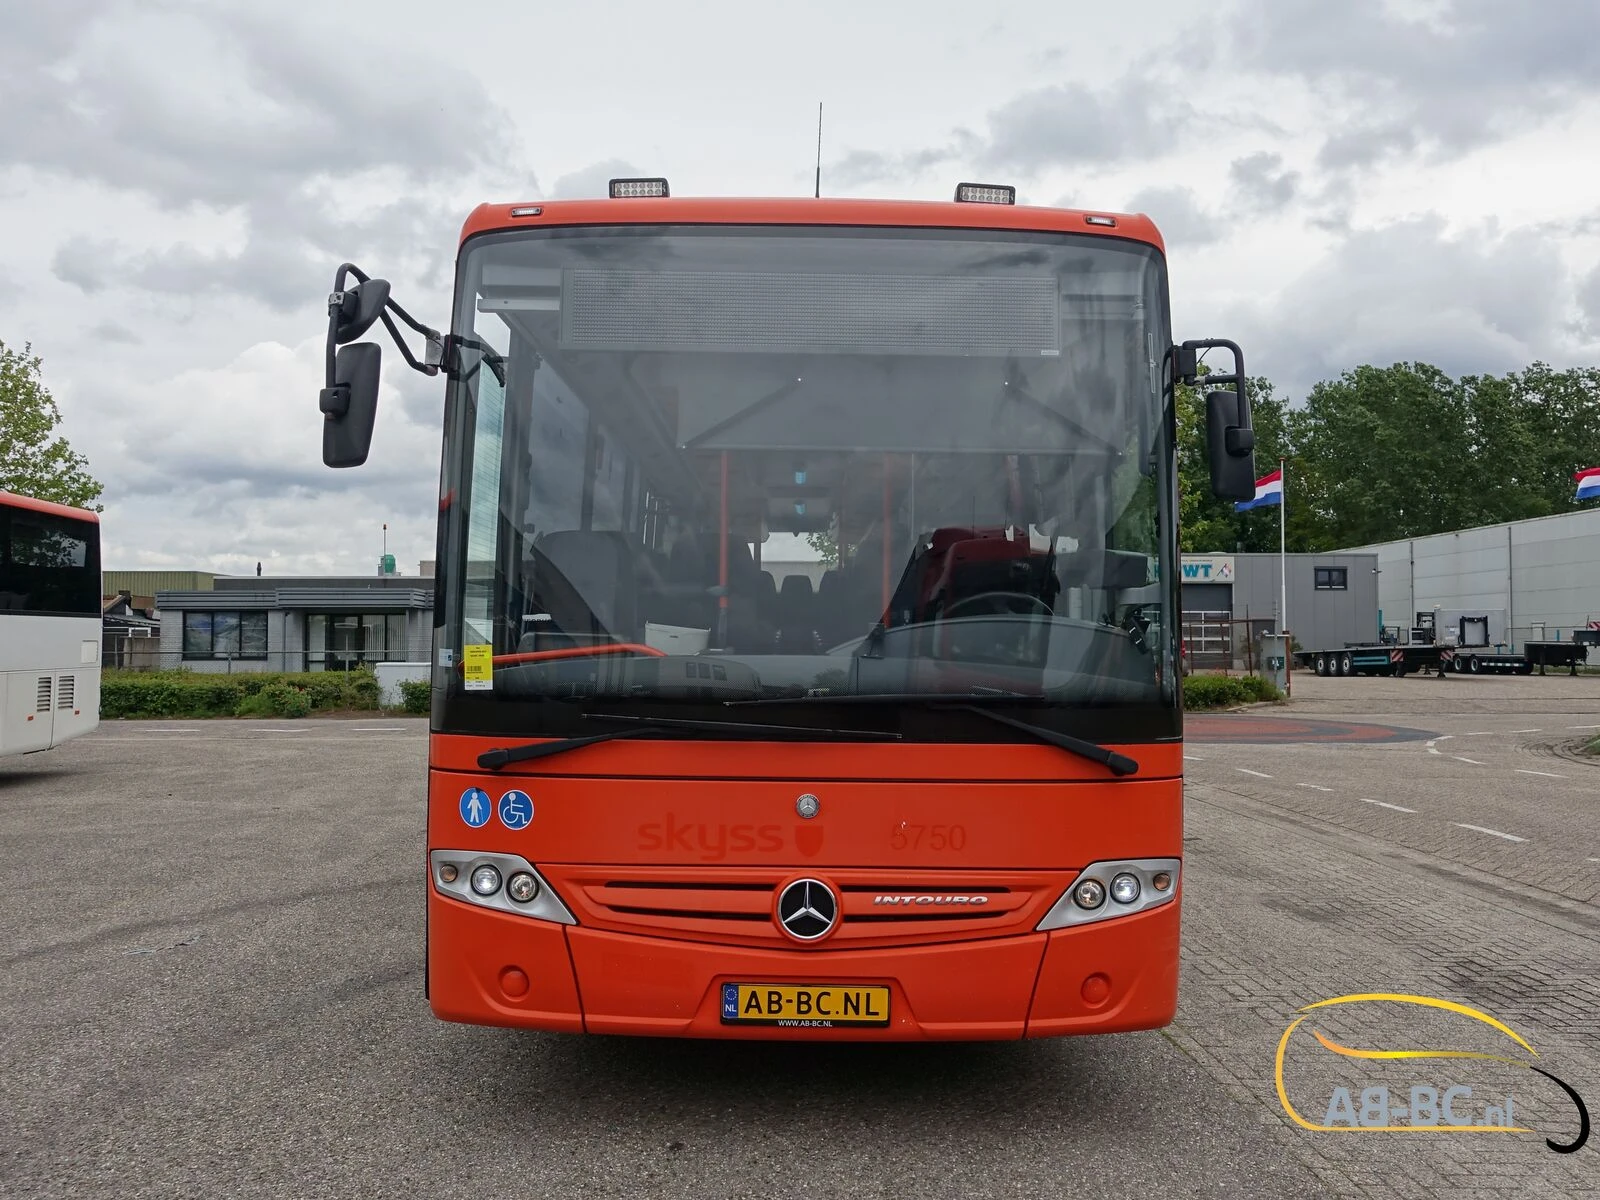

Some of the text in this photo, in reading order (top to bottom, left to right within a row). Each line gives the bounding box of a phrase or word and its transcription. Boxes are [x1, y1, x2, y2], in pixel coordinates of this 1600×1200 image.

[1183, 564, 1212, 578] WT
[637, 812, 784, 862] skyss
[890, 823, 967, 852] 5750
[873, 895, 989, 906] INTOURO
[725, 1003, 737, 1013] NL
[743, 990, 880, 1016] AB-BC.NL
[777, 1019, 833, 1028] WWW.AB-BC.NL
